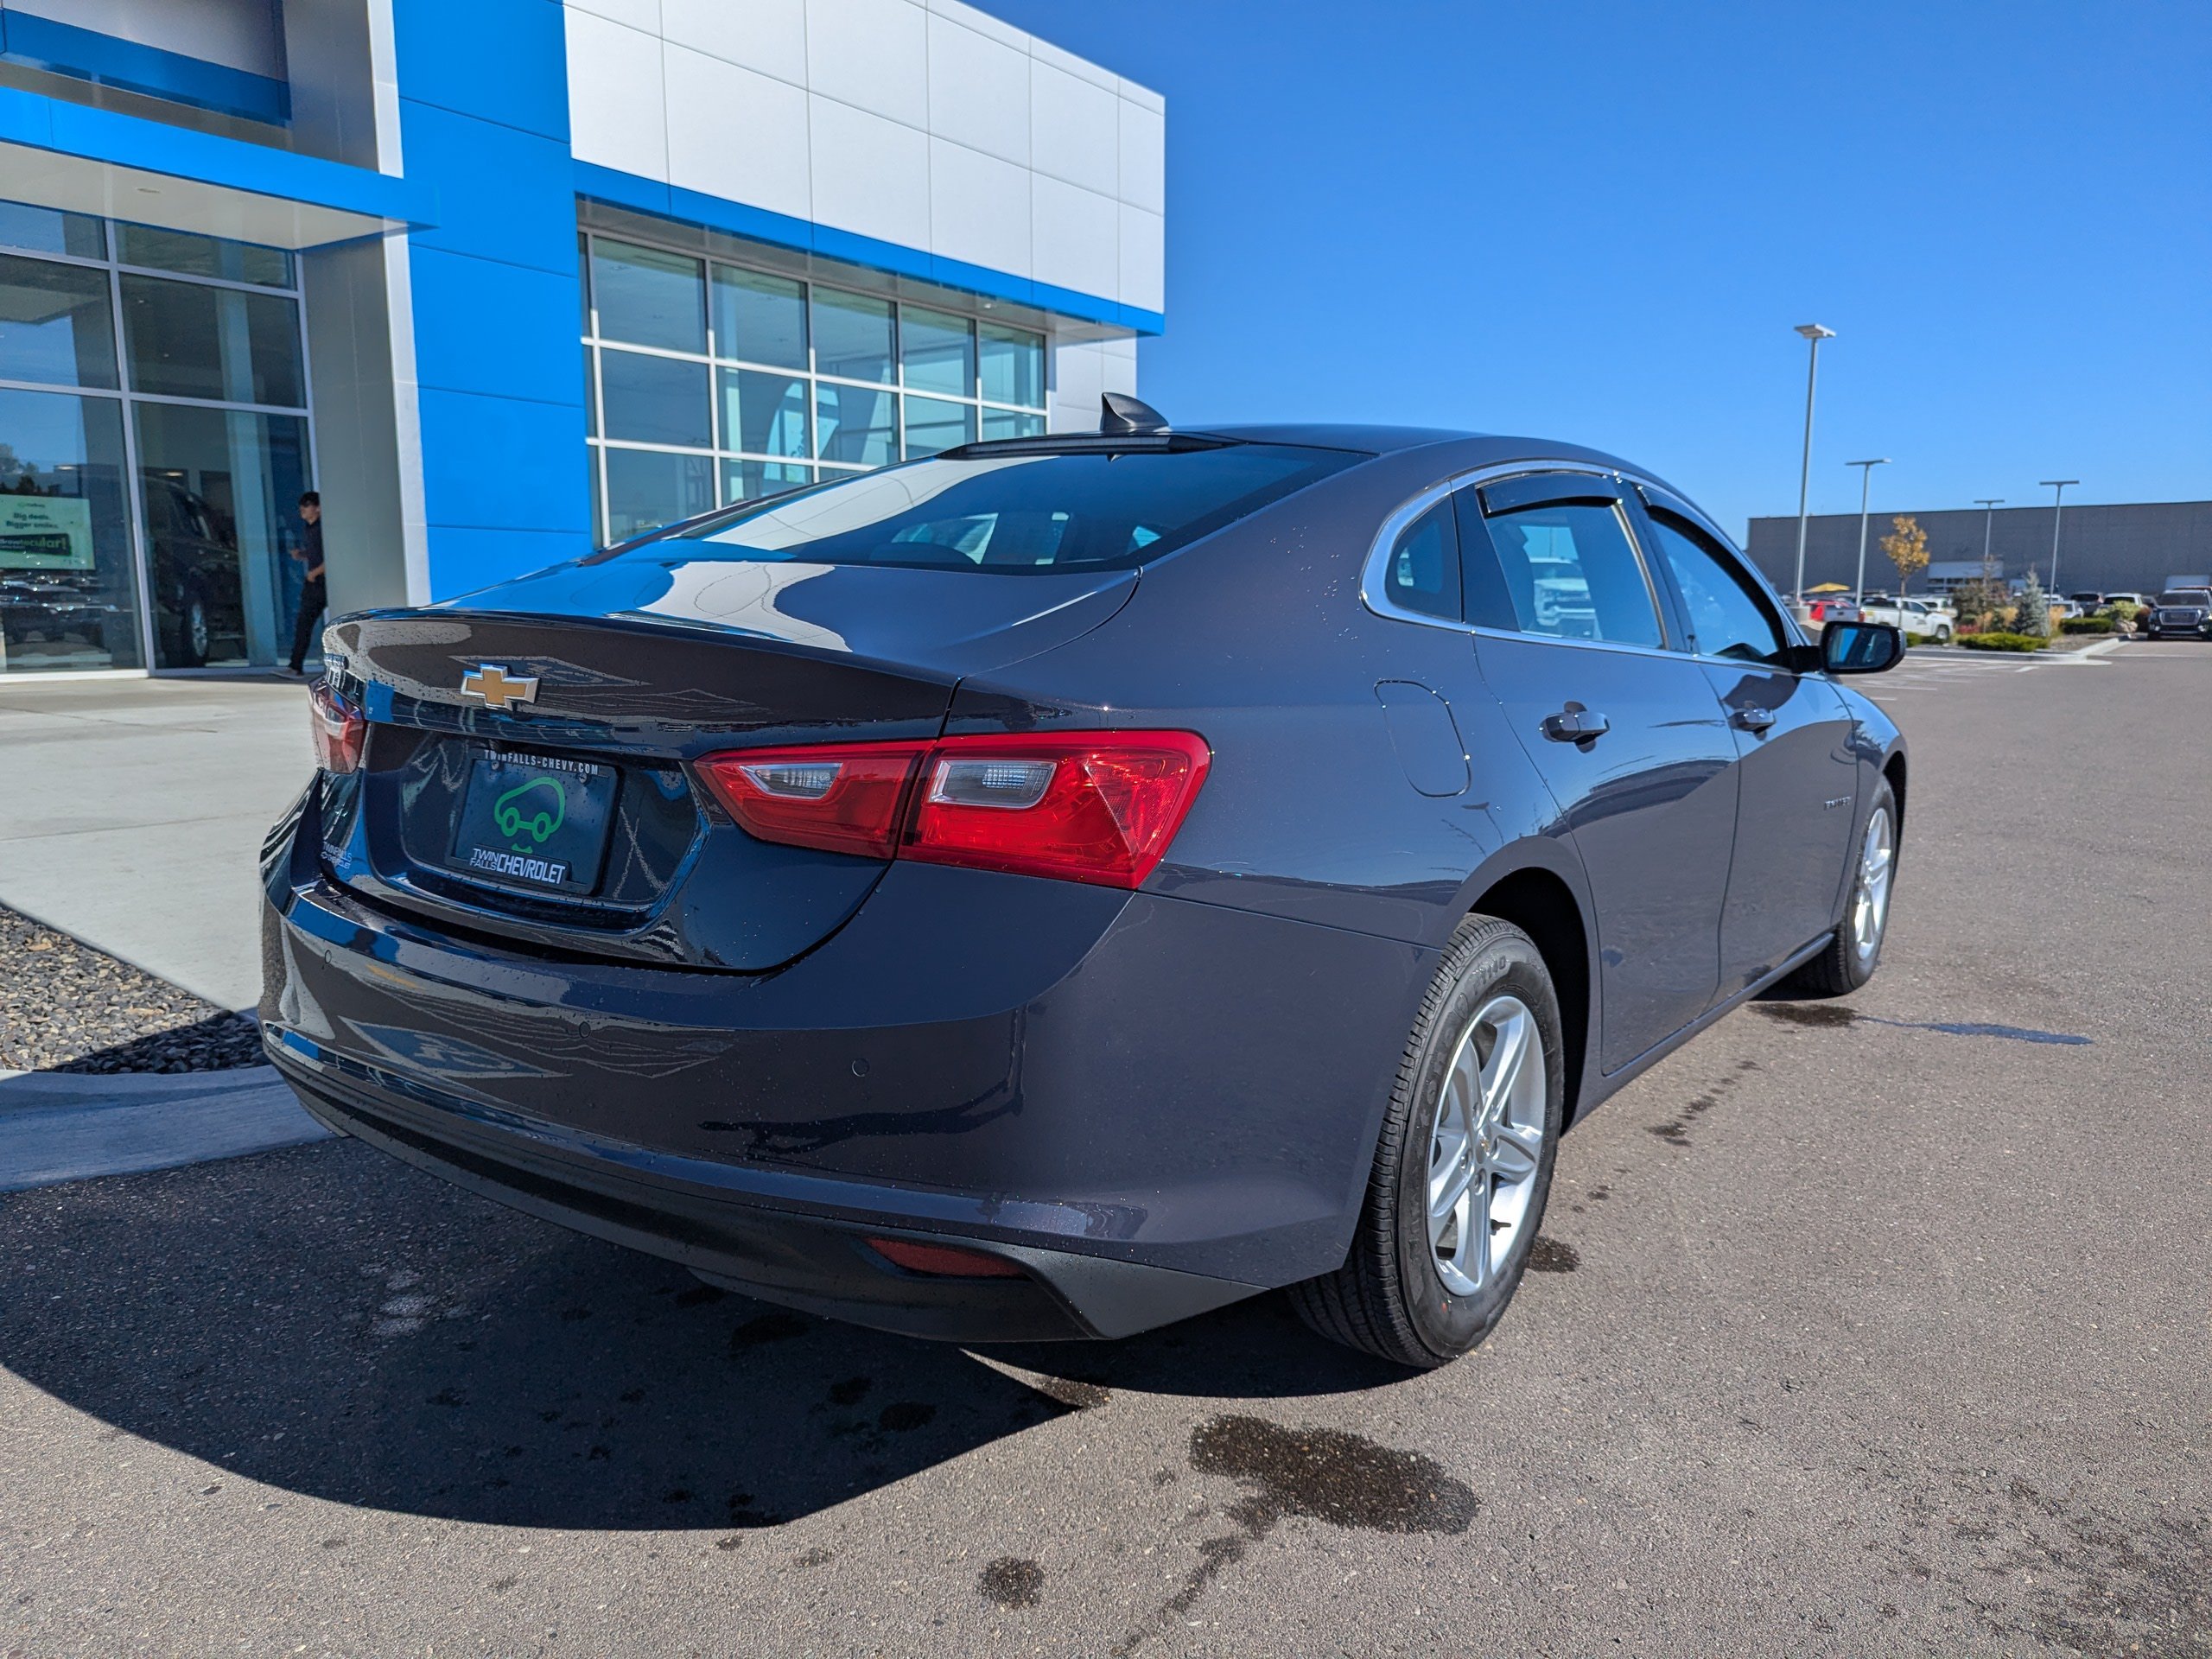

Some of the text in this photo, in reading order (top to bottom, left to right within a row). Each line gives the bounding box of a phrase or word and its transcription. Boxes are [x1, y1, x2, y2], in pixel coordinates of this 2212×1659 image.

[6, 520, 31, 529] Bigger
[473, 849, 499, 862] TWIN
[470, 859, 498, 871] FALLS
[497, 853, 566, 885] CHEVROLET
